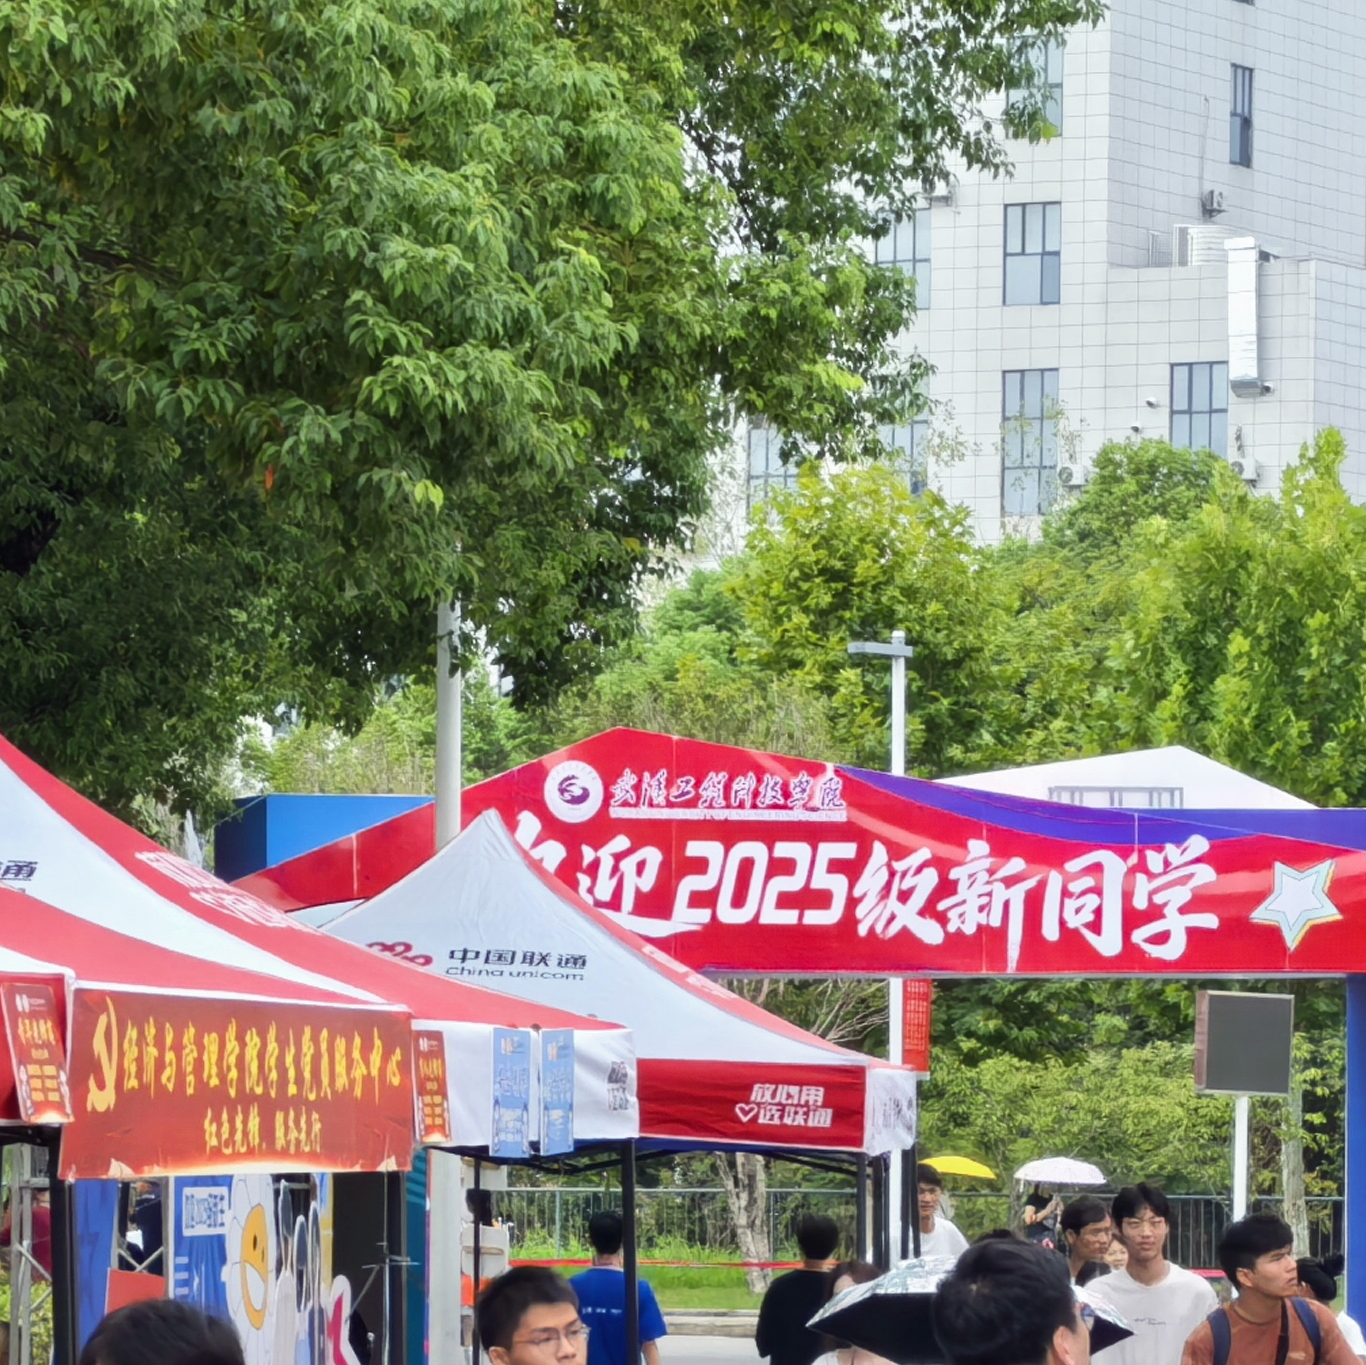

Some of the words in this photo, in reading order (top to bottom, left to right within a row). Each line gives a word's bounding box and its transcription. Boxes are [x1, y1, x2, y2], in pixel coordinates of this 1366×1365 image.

[448, 947, 588, 970] 中国联通
[123, 1016, 402, 1104] 经济与管理学院学生党员服务中心
[750, 1083, 825, 1106] 放心用
[757, 1104, 833, 1128] 选联通
